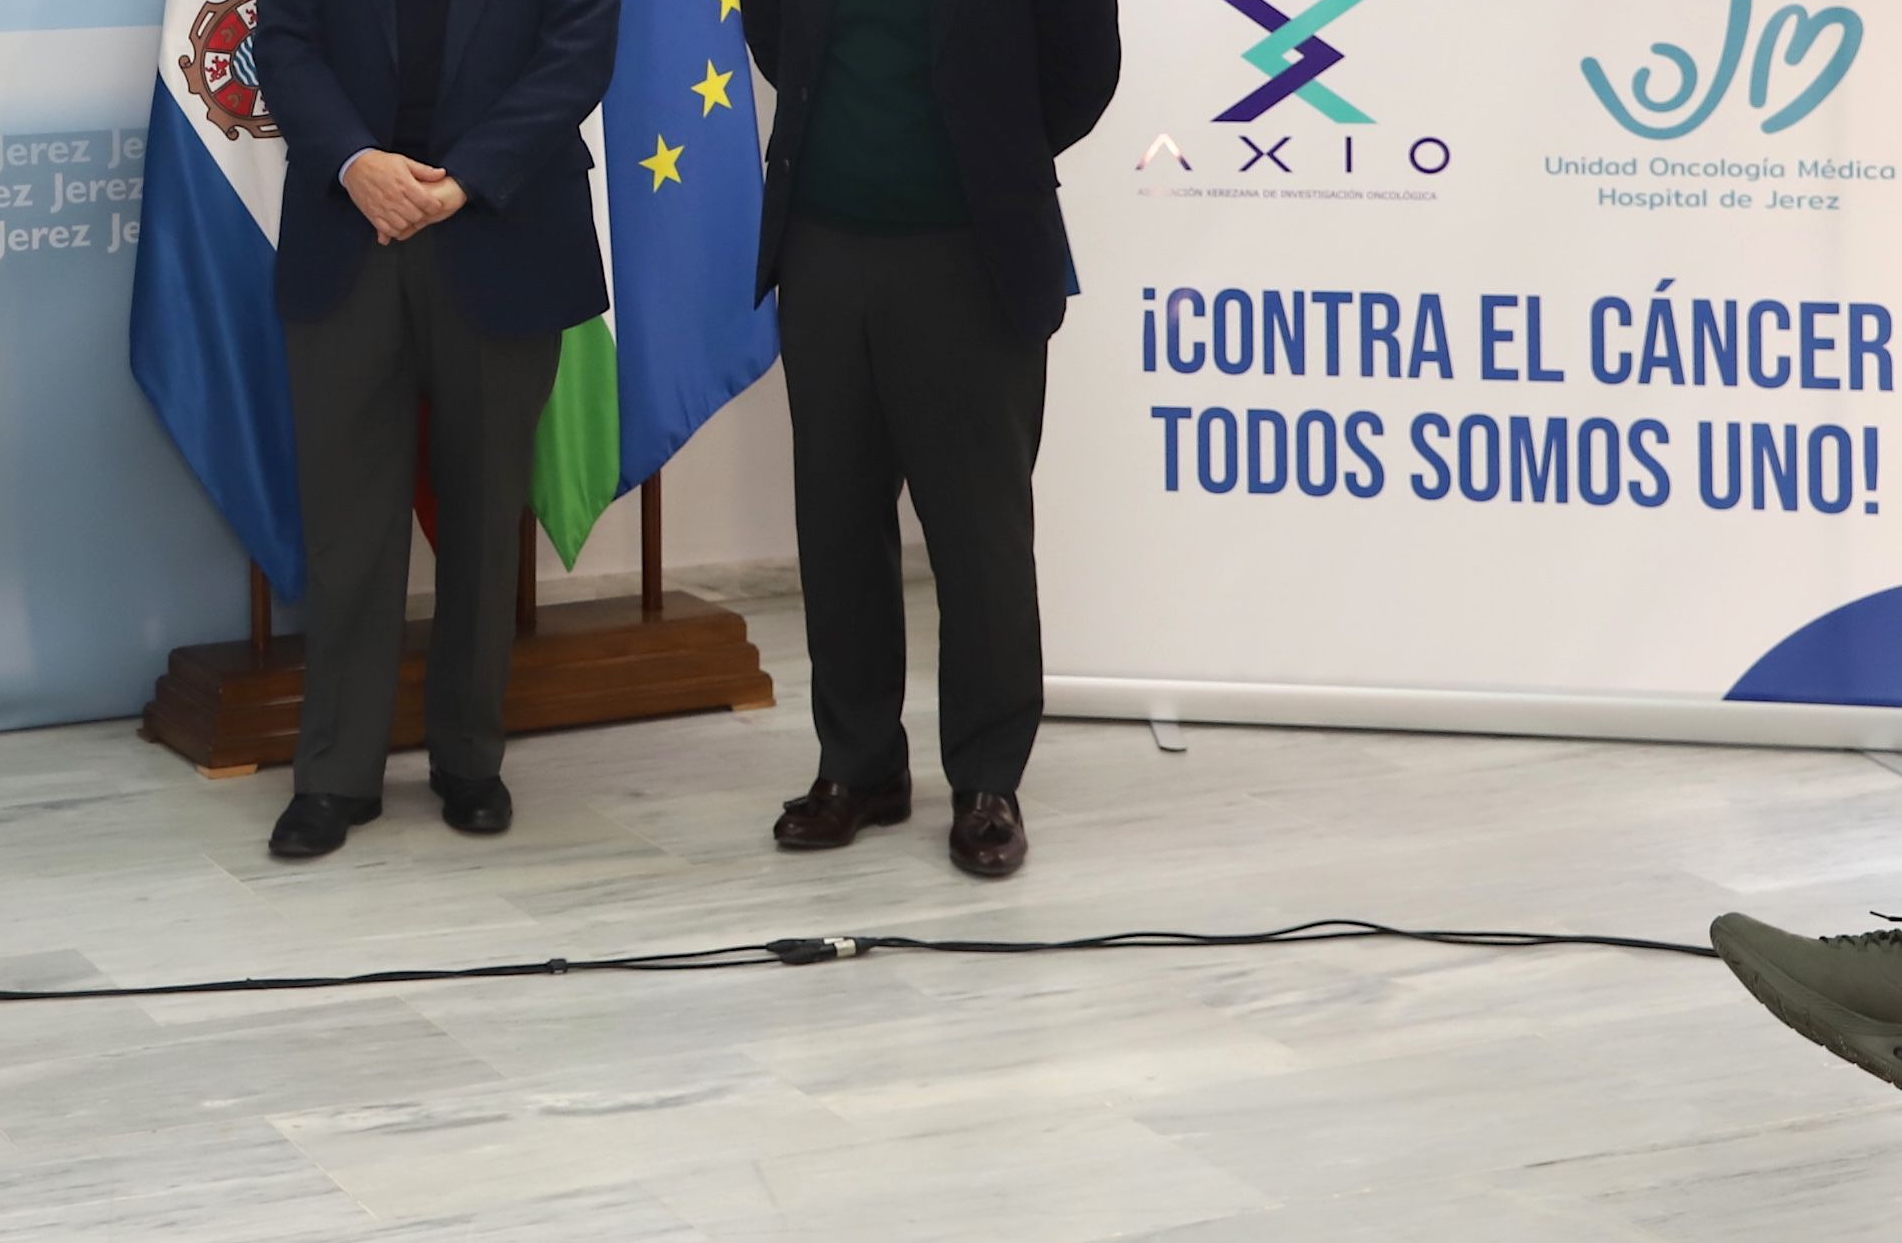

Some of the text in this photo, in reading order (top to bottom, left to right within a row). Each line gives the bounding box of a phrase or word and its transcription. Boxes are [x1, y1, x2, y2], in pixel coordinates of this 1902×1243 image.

[1544, 156, 1897, 181] Unidad Oncología Médica
[50, 173, 144, 214] Jerez
[1597, 187, 1841, 211] Hospital de Jerez
[1141, 277, 1895, 392] ¡CONTRA EL CÁNCER
[1150, 406, 1880, 515] TODOS SOMOS UNO!
